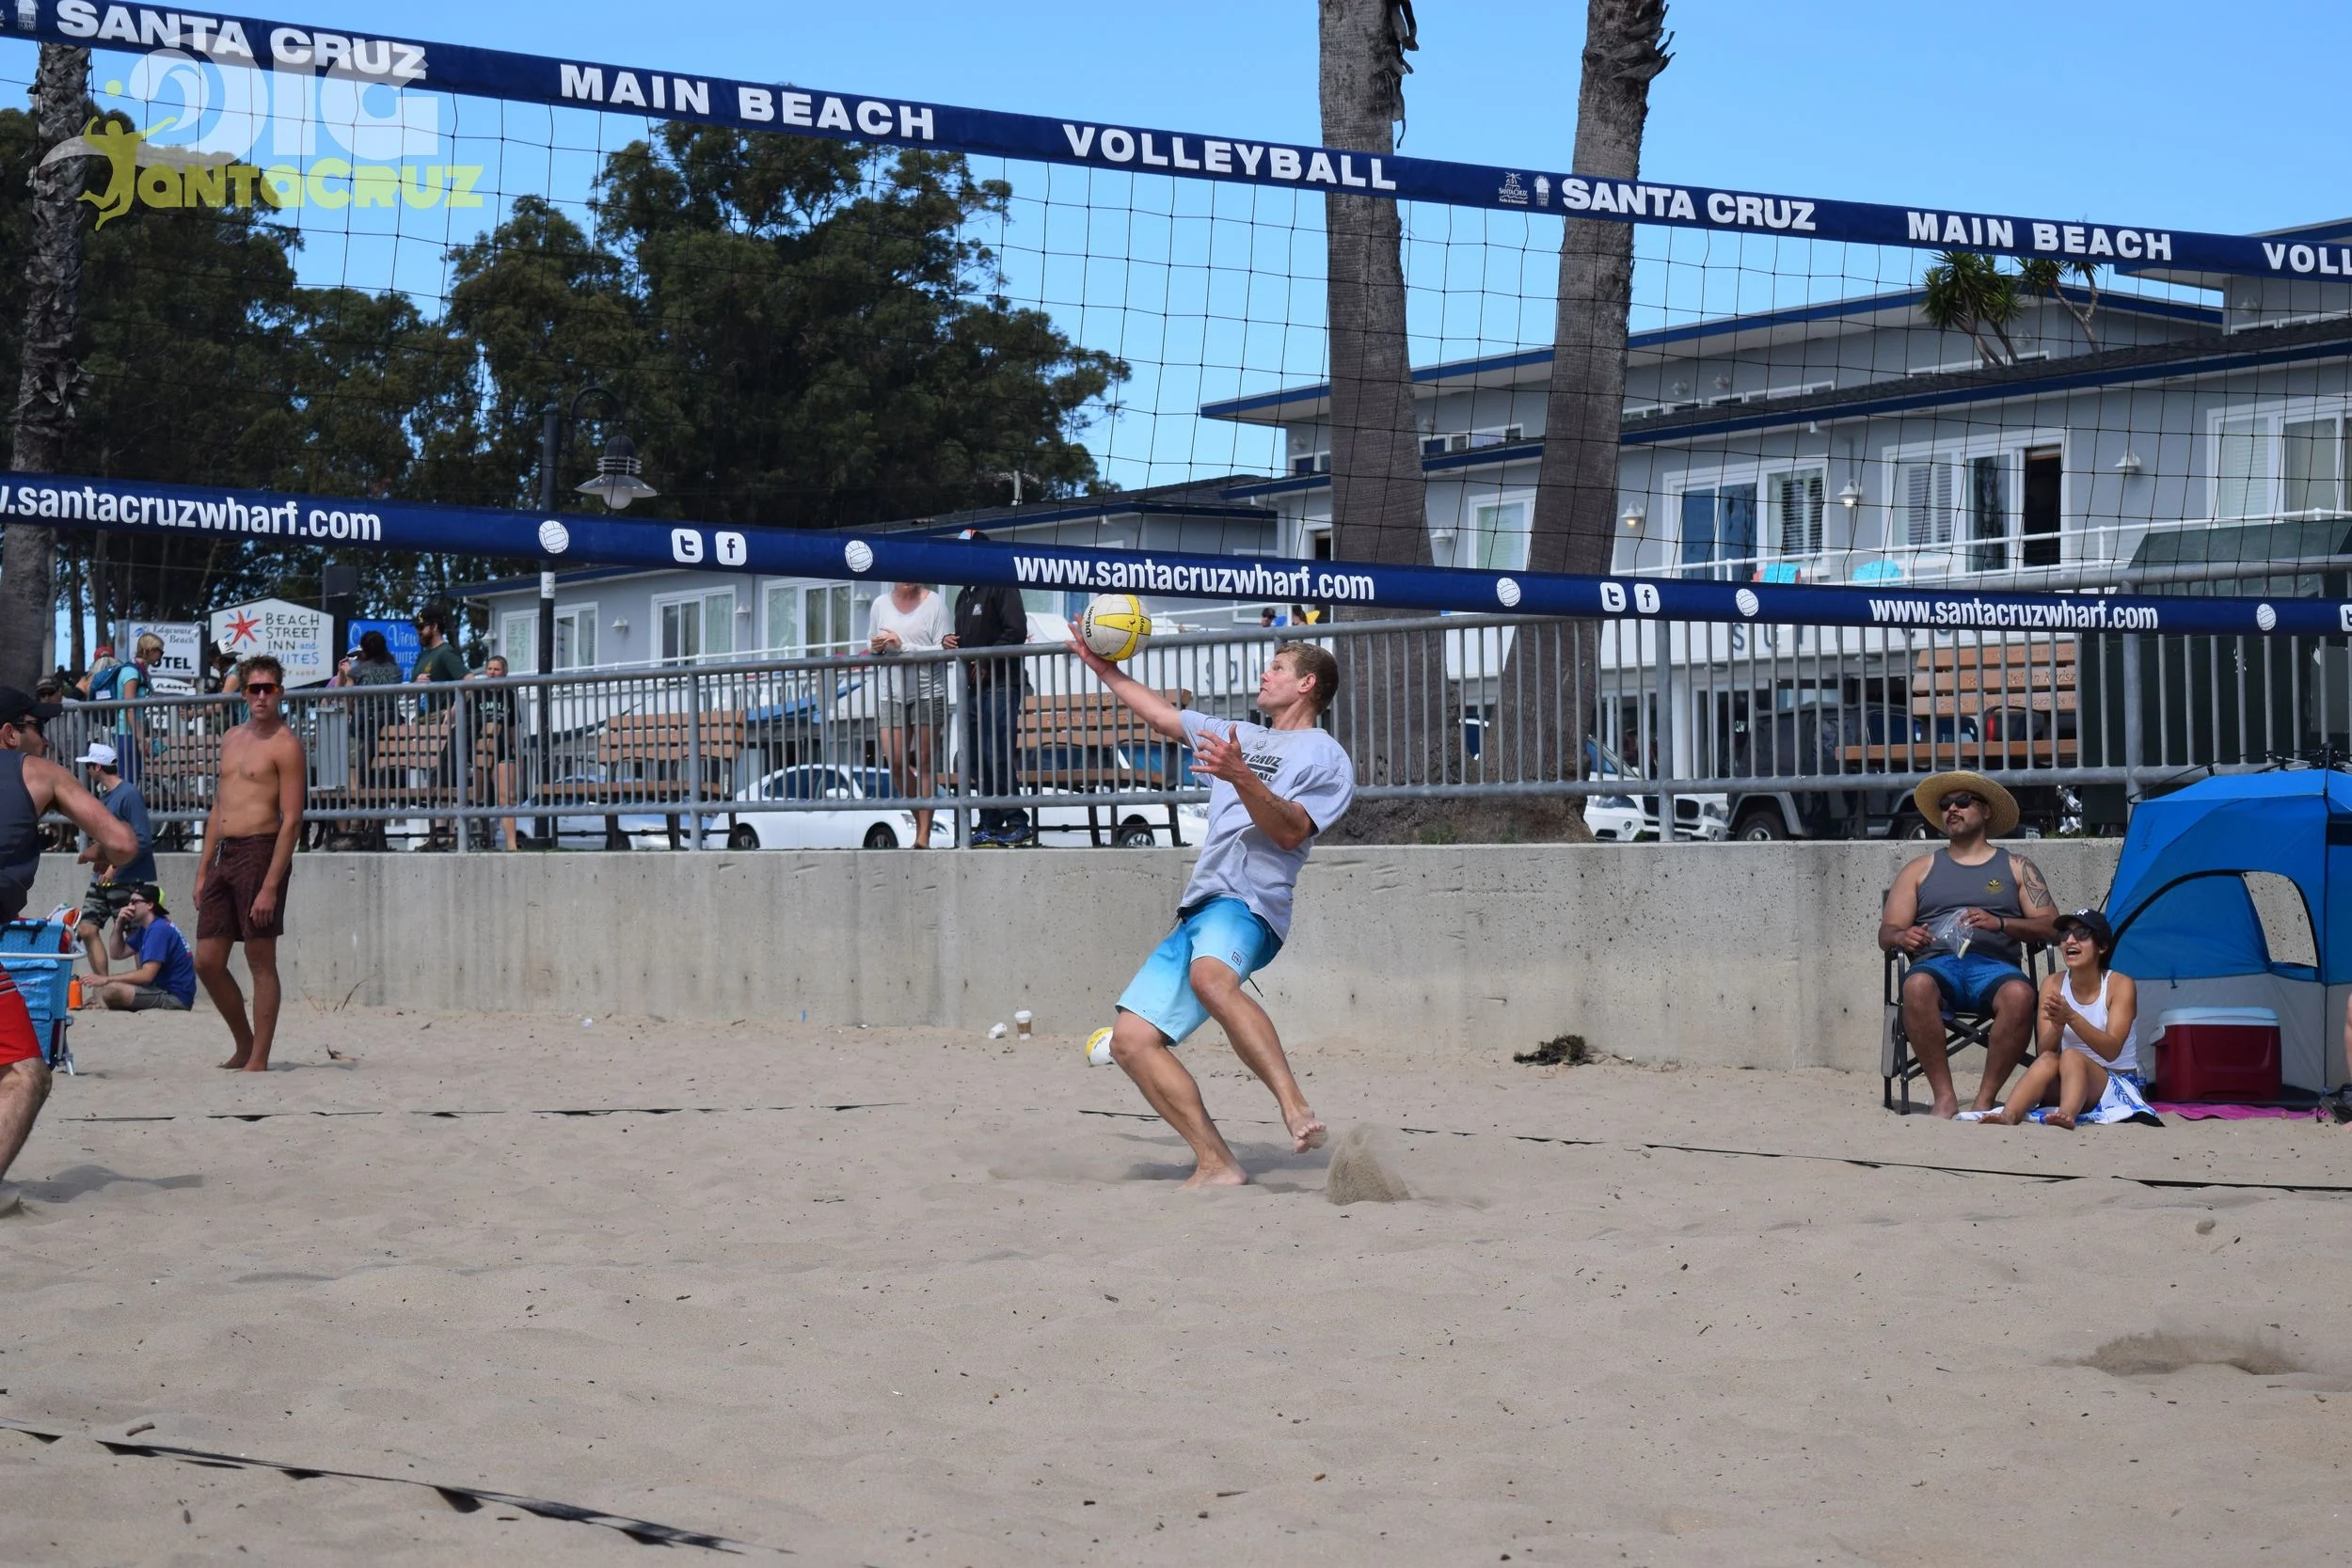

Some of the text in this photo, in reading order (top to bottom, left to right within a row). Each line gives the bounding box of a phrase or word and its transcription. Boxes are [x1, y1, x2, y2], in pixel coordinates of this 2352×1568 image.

[56, 0, 428, 80] SANTA CRUZ
[559, 63, 934, 140] MAIN BEACH
[1063, 123, 1397, 190] VOLLEYBALL
[1562, 178, 1817, 231] SANTA CRUZ
[1907, 211, 2172, 261] MAIN BEACH
[2262, 242, 2352, 276] VOLL
[1013, 556, 1375, 600] www.santacruzwharf.com
[265, 612, 320, 626] BEACH
[1868, 597, 2158, 629] www.santacruzwharf.com
[265, 626, 319, 640] STREET
[268, 641, 295, 651] INN
[266, 651, 319, 665] UITES
[1248, 753, 1283, 769] CRUZ
